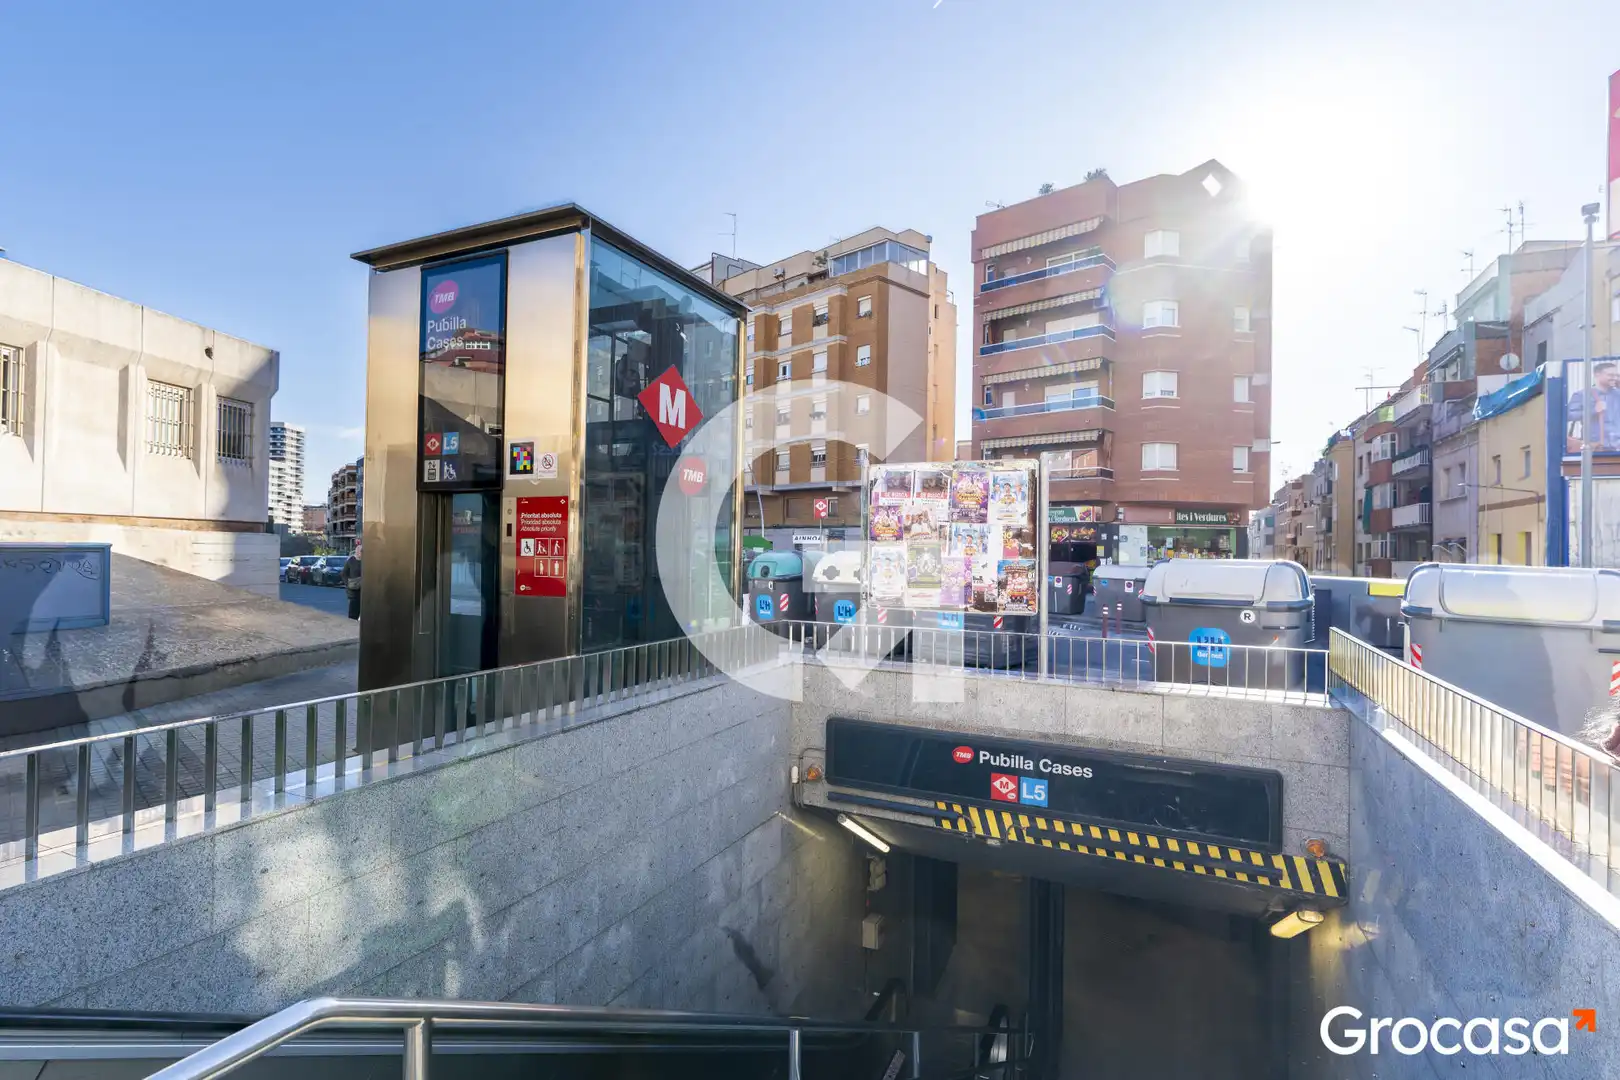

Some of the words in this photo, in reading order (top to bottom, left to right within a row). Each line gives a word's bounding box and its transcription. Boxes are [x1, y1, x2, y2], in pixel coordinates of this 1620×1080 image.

[435, 291, 455, 305] TMB
[427, 316, 467, 333] Pubilla
[427, 336, 464, 350] Cases
[659, 382, 686, 430] M
[443, 436, 458, 450] L5
[683, 468, 704, 483] TMB
[1194, 512, 1227, 522] Verdures
[1243, 612, 1252, 621] R
[956, 751, 972, 759] TMB
[979, 750, 1034, 771] Pubilla
[1039, 758, 1094, 779] Cases
[999, 781, 1009, 790] M
[1022, 782, 1046, 801] L5
